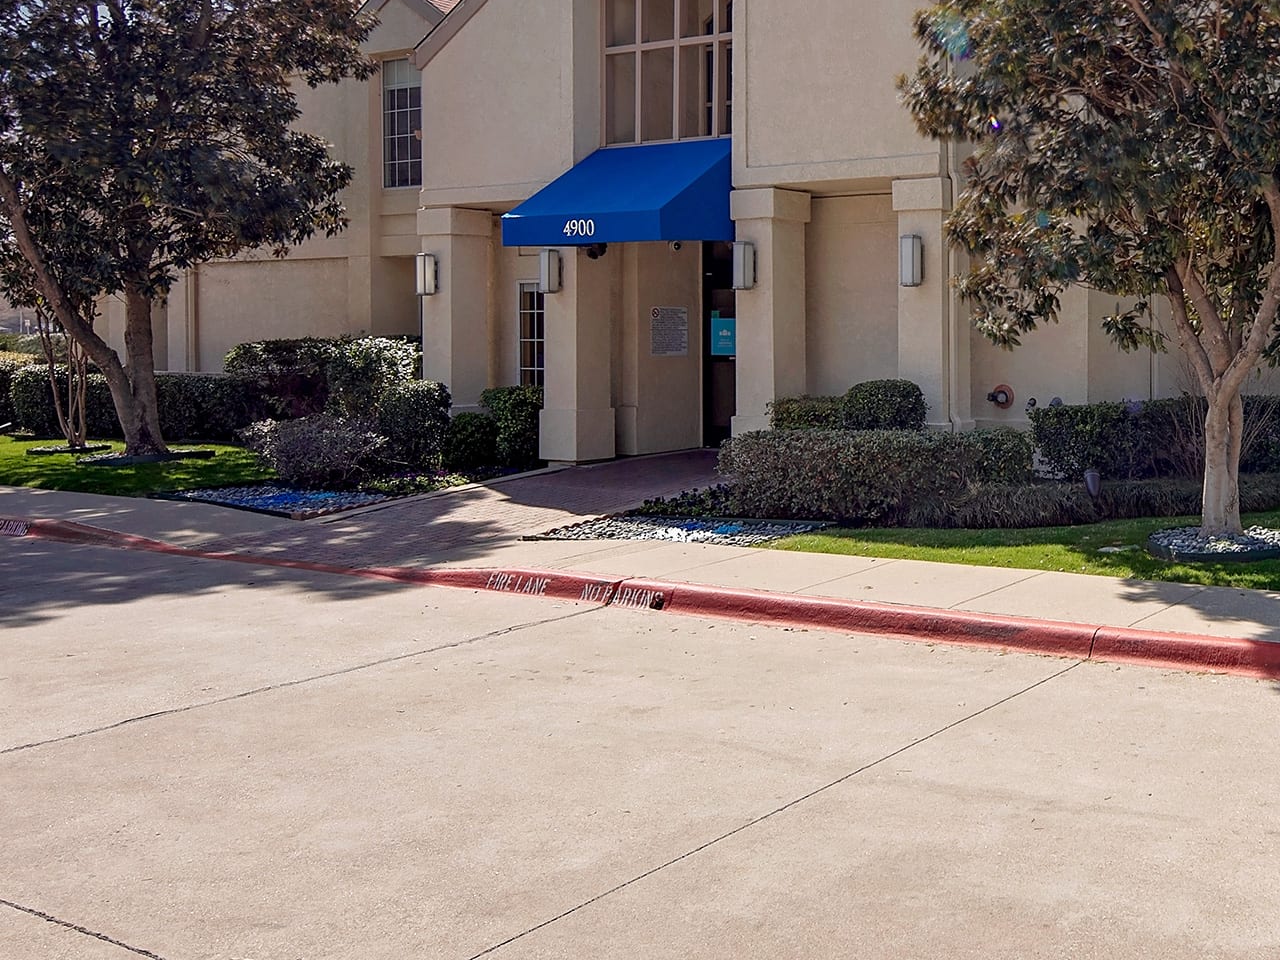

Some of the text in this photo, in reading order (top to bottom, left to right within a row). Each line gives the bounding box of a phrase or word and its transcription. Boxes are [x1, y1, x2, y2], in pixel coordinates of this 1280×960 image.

[563, 219, 595, 237] 4900
[486, 572, 552, 596] FIRE LANE
[580, 583, 601, 601] NO
